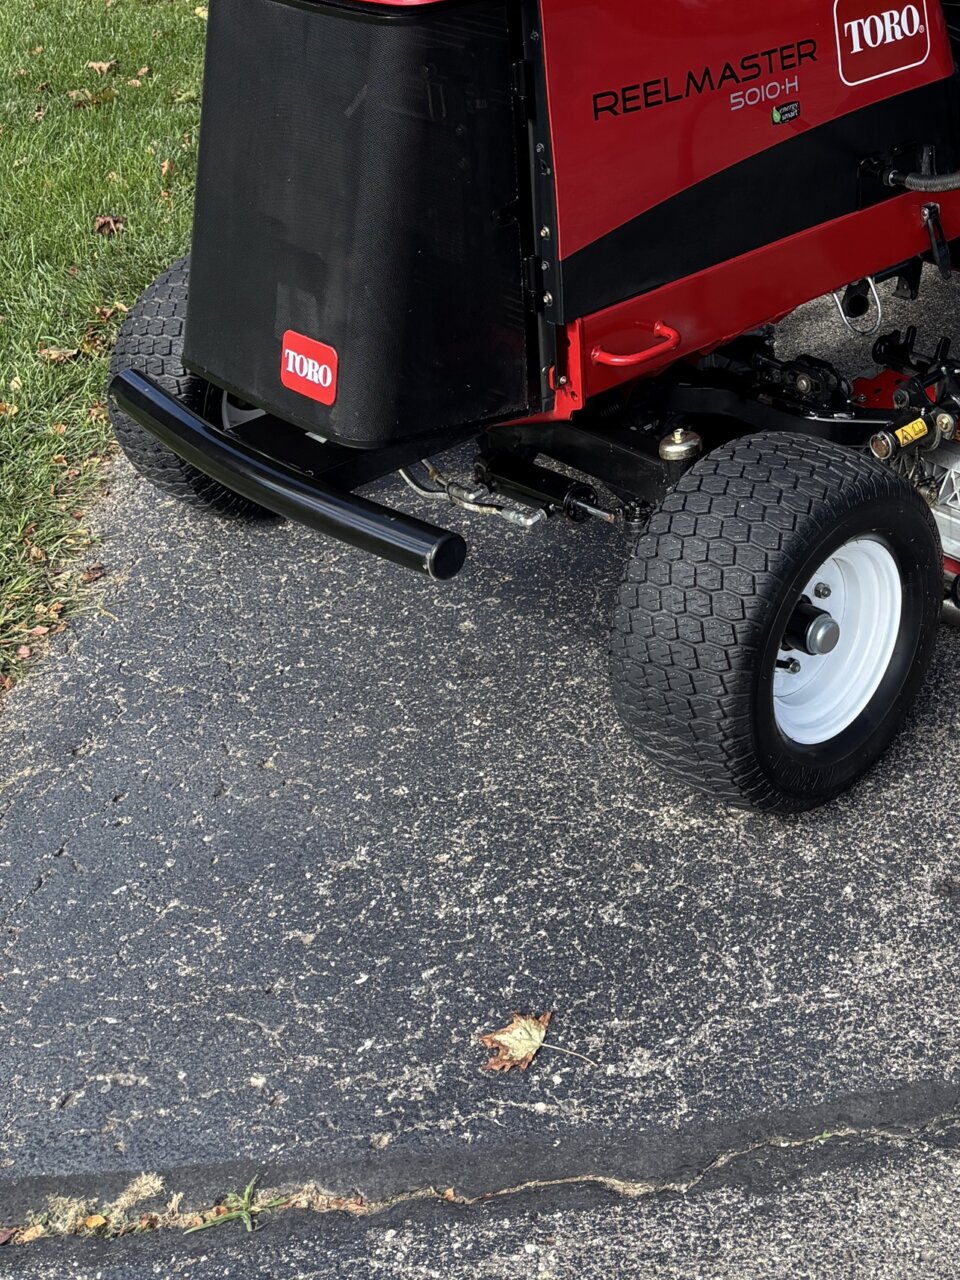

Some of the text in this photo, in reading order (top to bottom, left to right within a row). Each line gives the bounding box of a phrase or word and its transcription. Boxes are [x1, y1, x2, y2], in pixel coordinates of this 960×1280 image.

[844, 4, 920, 54] TORO
[592, 38, 818, 121] REELMASTER
[780, 102, 799, 113] energy
[781, 110, 799, 121] smart
[285, 348, 332, 387] TORO
